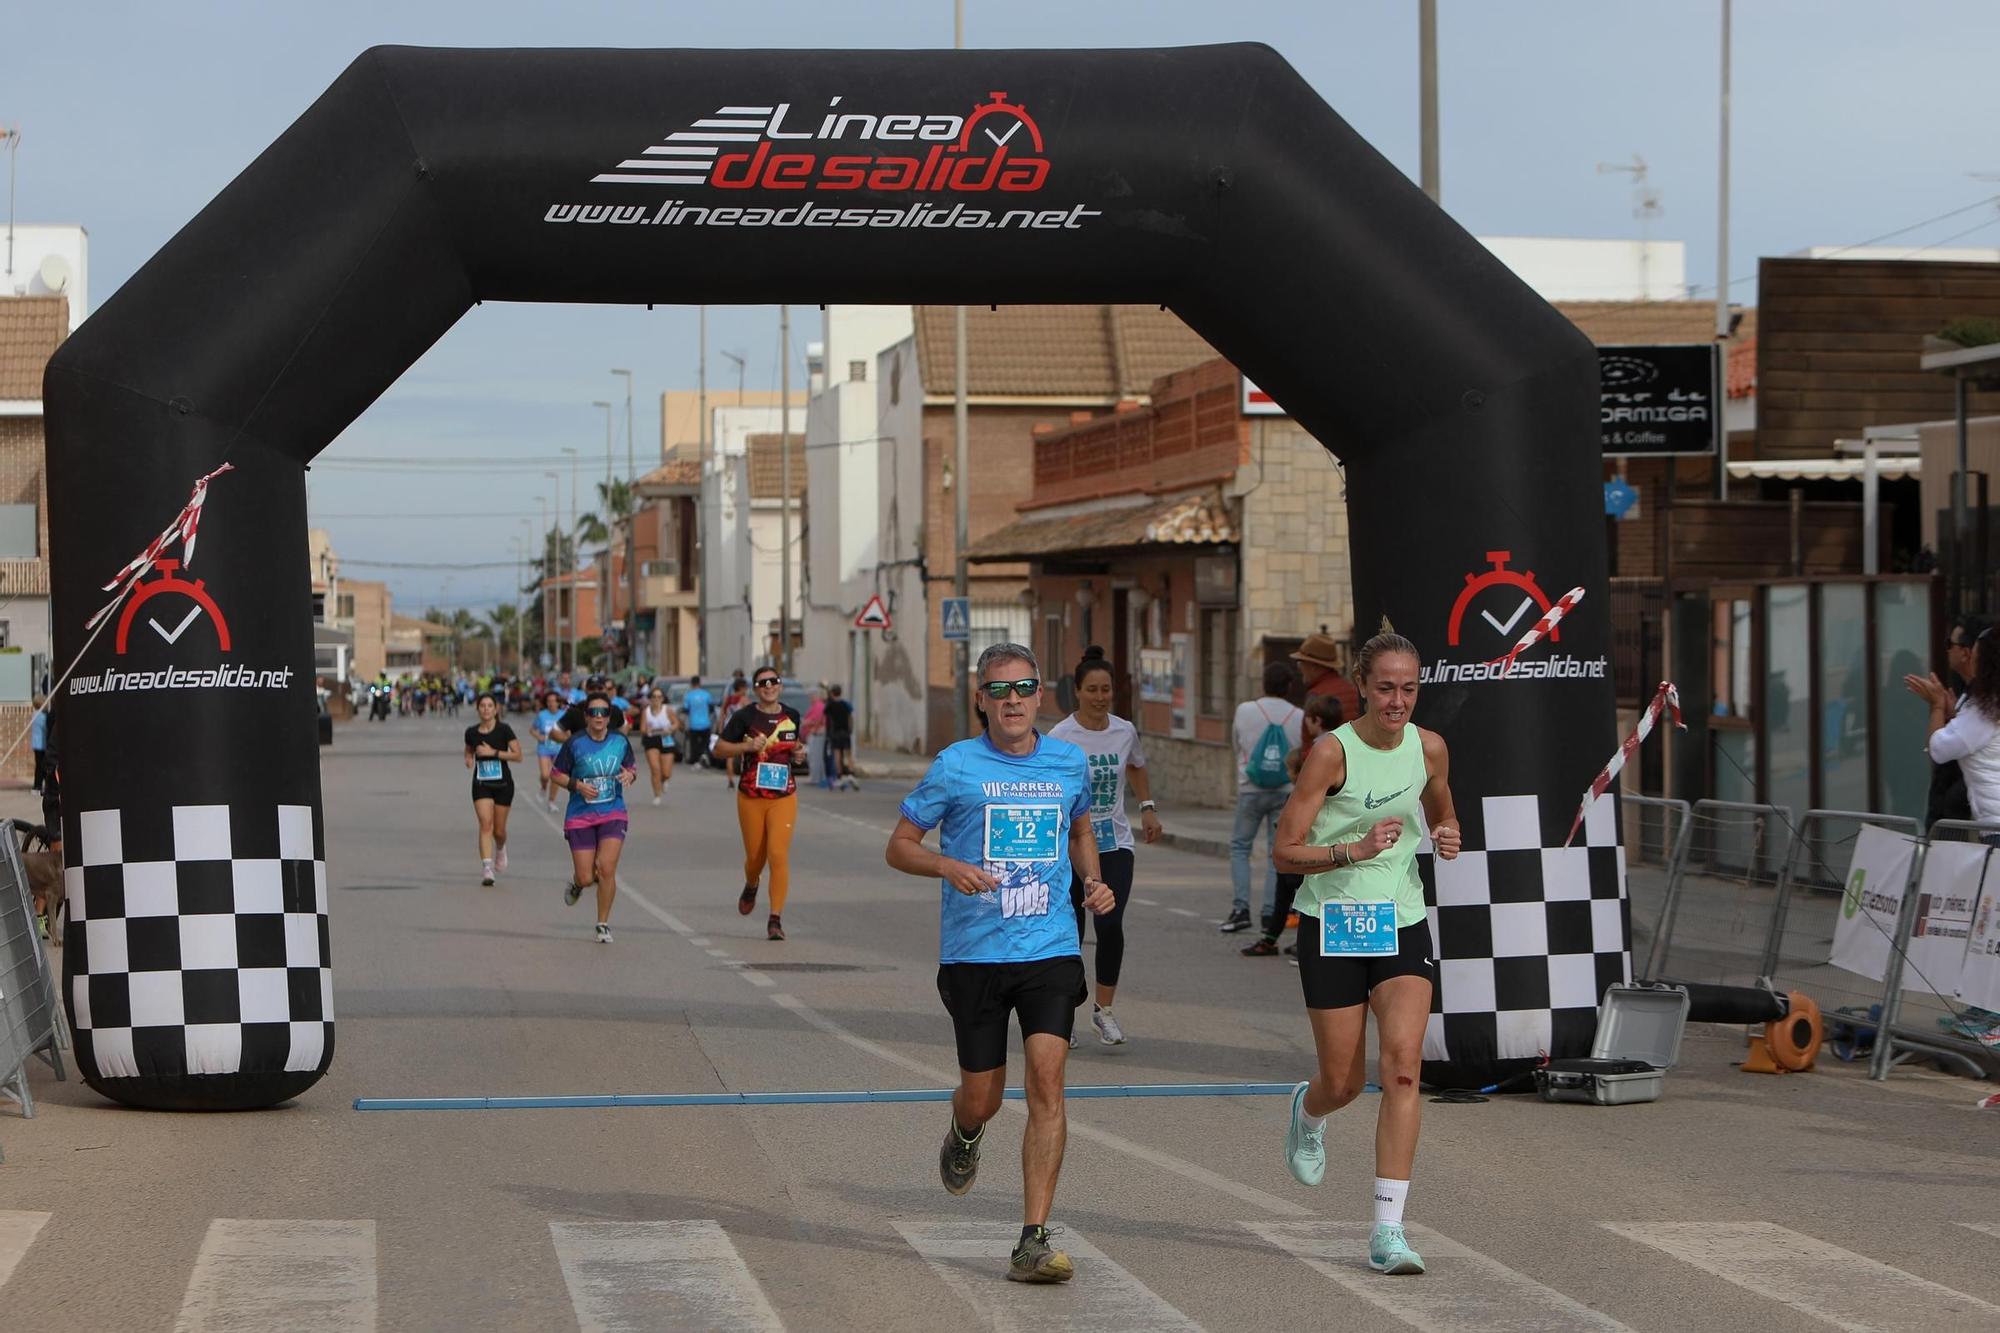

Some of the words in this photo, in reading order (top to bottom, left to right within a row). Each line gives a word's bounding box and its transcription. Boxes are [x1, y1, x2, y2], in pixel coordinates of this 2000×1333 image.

[765, 96, 964, 141] Línea
[543, 200, 1102, 229] www.lineadesalida.net
[1601, 406, 1707, 422] ORMIGA
[1624, 431, 1666, 444] Coffee
[1420, 655, 1607, 683] w.lineadesalida.net
[70, 664, 293, 695] www.lineadesalida.net
[1088, 753, 1119, 767] SAN
[982, 782, 1000, 798] VII
[1001, 783, 1063, 792] CARRERA
[1015, 822, 1036, 839] 12
[1344, 917, 1377, 933] 150
